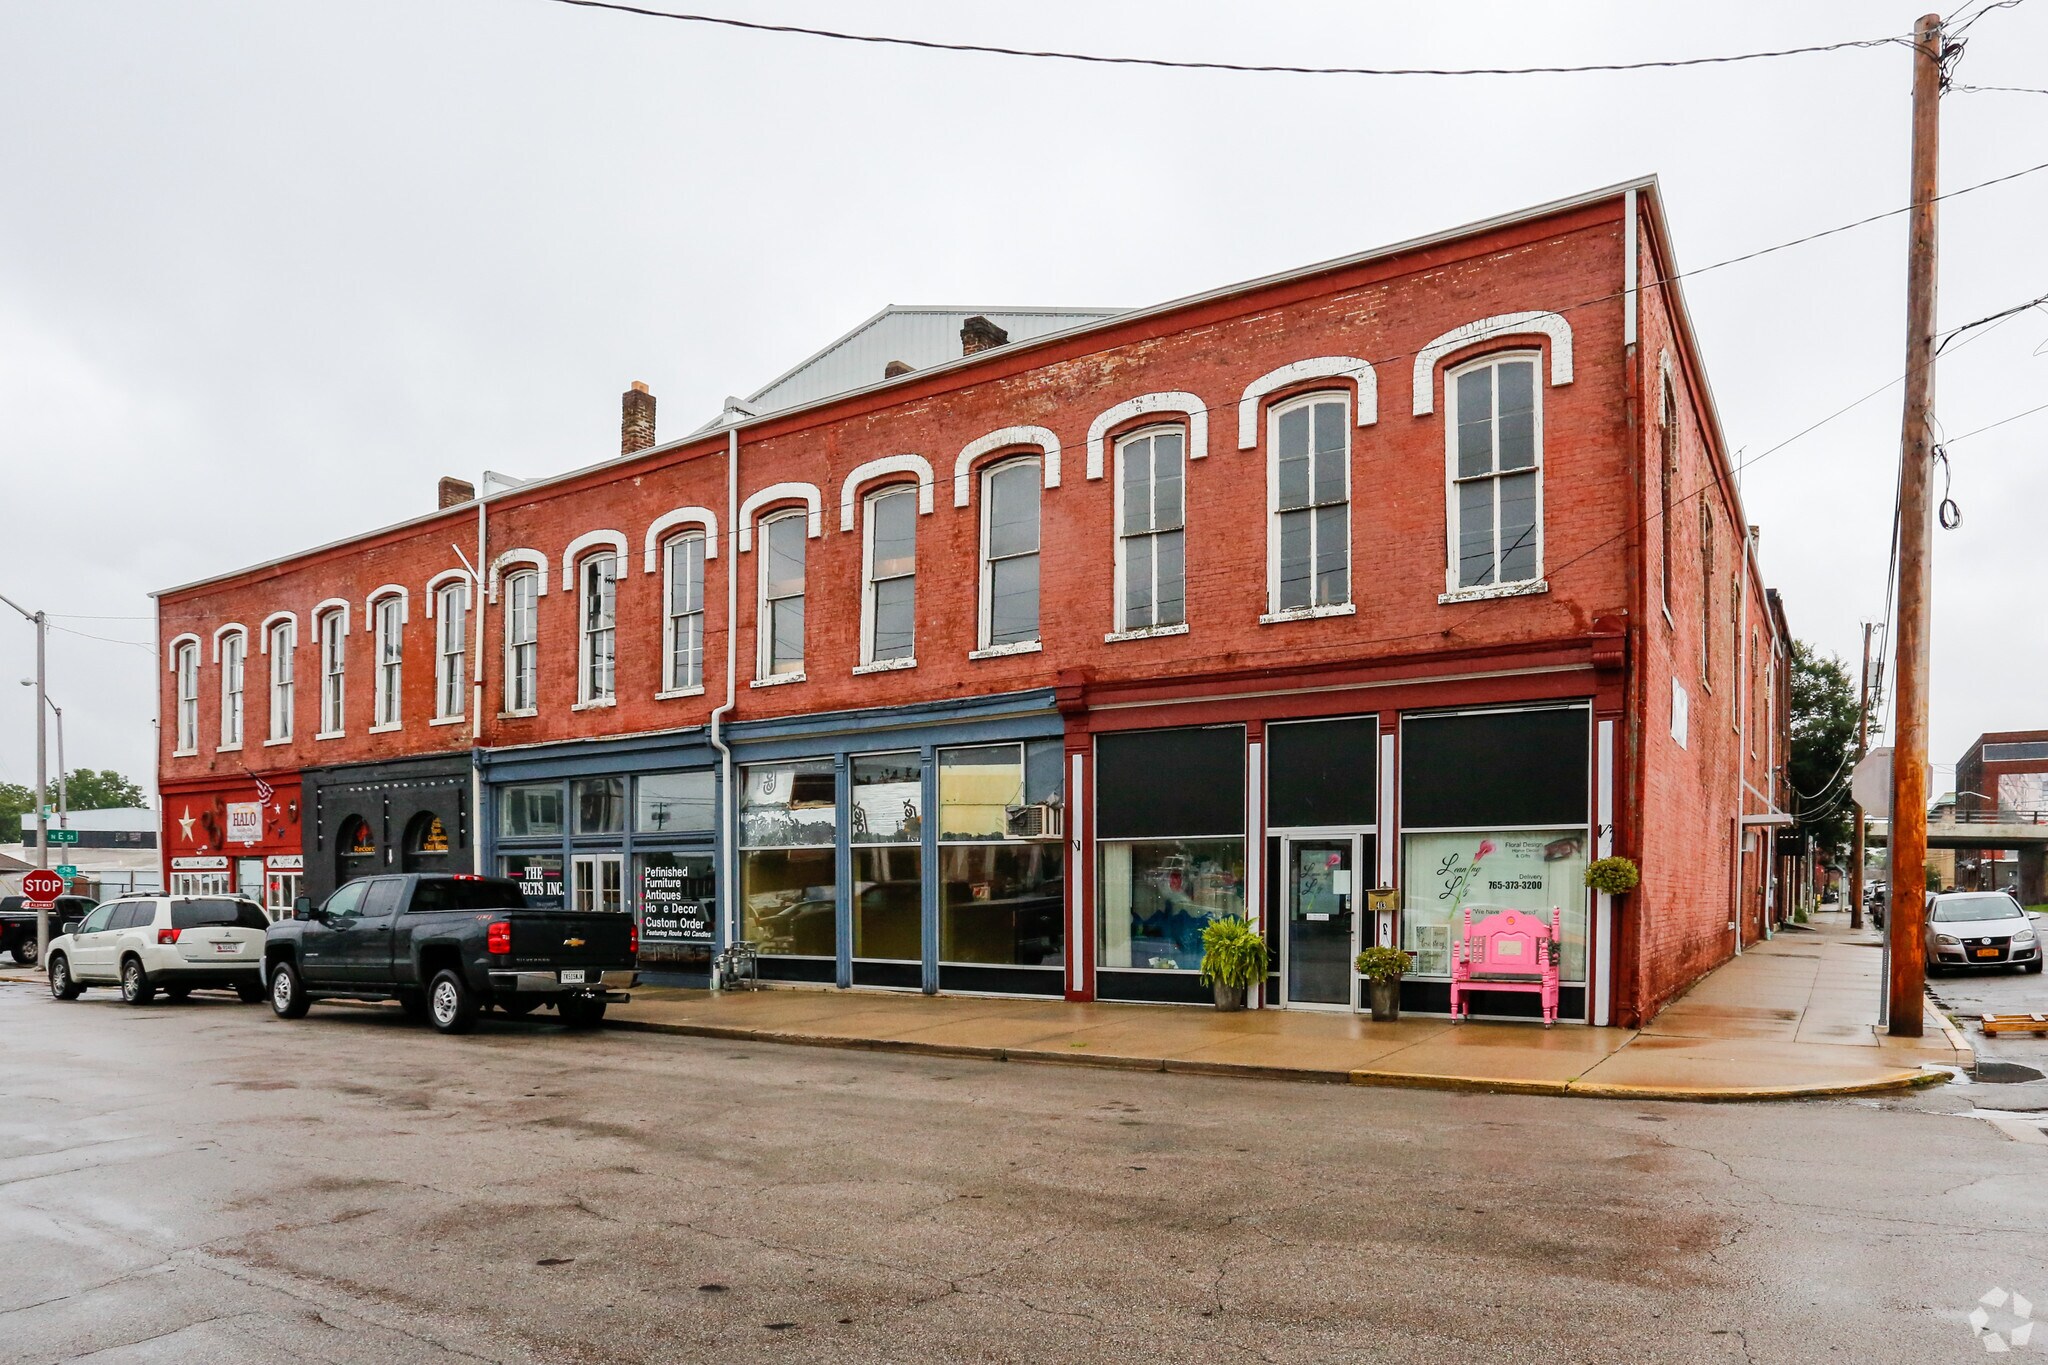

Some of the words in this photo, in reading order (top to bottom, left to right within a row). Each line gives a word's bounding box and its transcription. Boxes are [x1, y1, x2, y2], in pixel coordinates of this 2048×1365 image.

[232, 811, 257, 827] HALO
[58, 832, 64, 840] E
[1522, 841, 1544, 849] Design
[524, 866, 543, 880] THE
[24, 879, 62, 893] STOP
[546, 881, 565, 896] INC.
[645, 877, 681, 888] Furniture
[1488, 880, 1543, 890] 765-373-3200
[645, 889, 681, 902] Antiques
[671, 903, 698, 914] Decor
[645, 916, 677, 928] Custom
[680, 917, 705, 929] Order
[646, 929, 668, 938] Featuring
[668, 929, 682, 937] Route
[683, 930, 691, 938] 40
[691, 930, 712, 938] Candles
